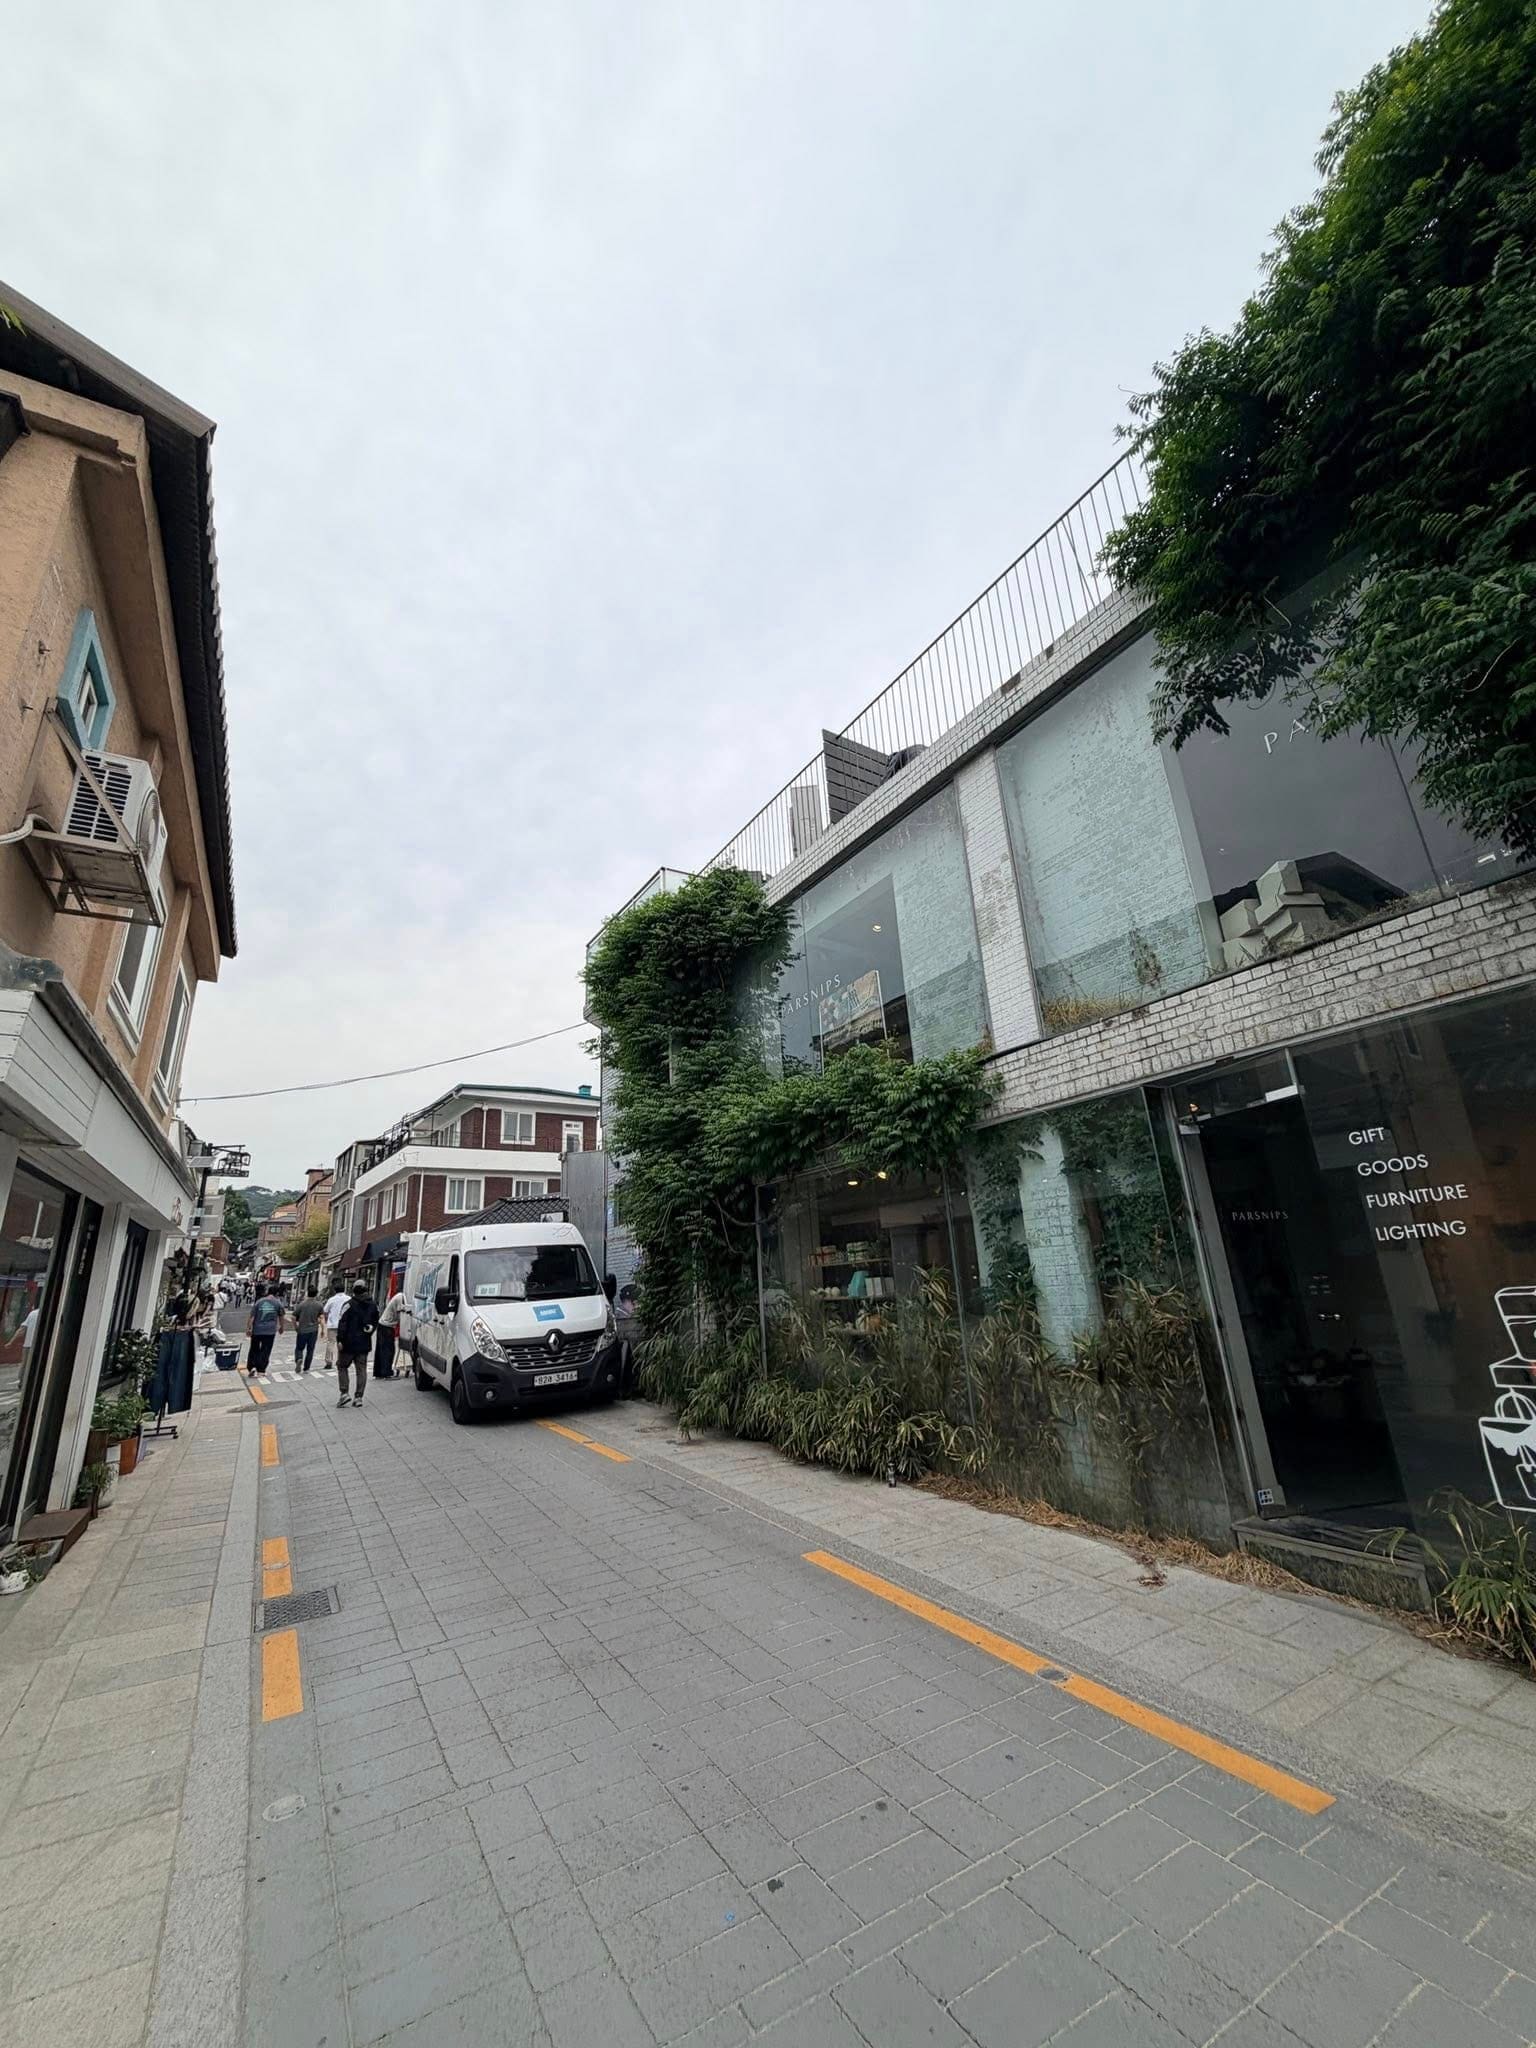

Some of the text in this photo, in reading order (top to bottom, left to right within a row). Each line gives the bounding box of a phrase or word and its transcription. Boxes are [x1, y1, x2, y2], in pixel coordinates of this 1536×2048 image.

[781, 974, 841, 1018] PARSNIPS
[1348, 1126, 1384, 1145] GIFT
[1357, 1153, 1429, 1176] GOODS
[1366, 1184, 1469, 1209] FURNITURE
[1231, 1210, 1289, 1221] PARSNIPS
[1375, 1220, 1466, 1241] LIGHTING
